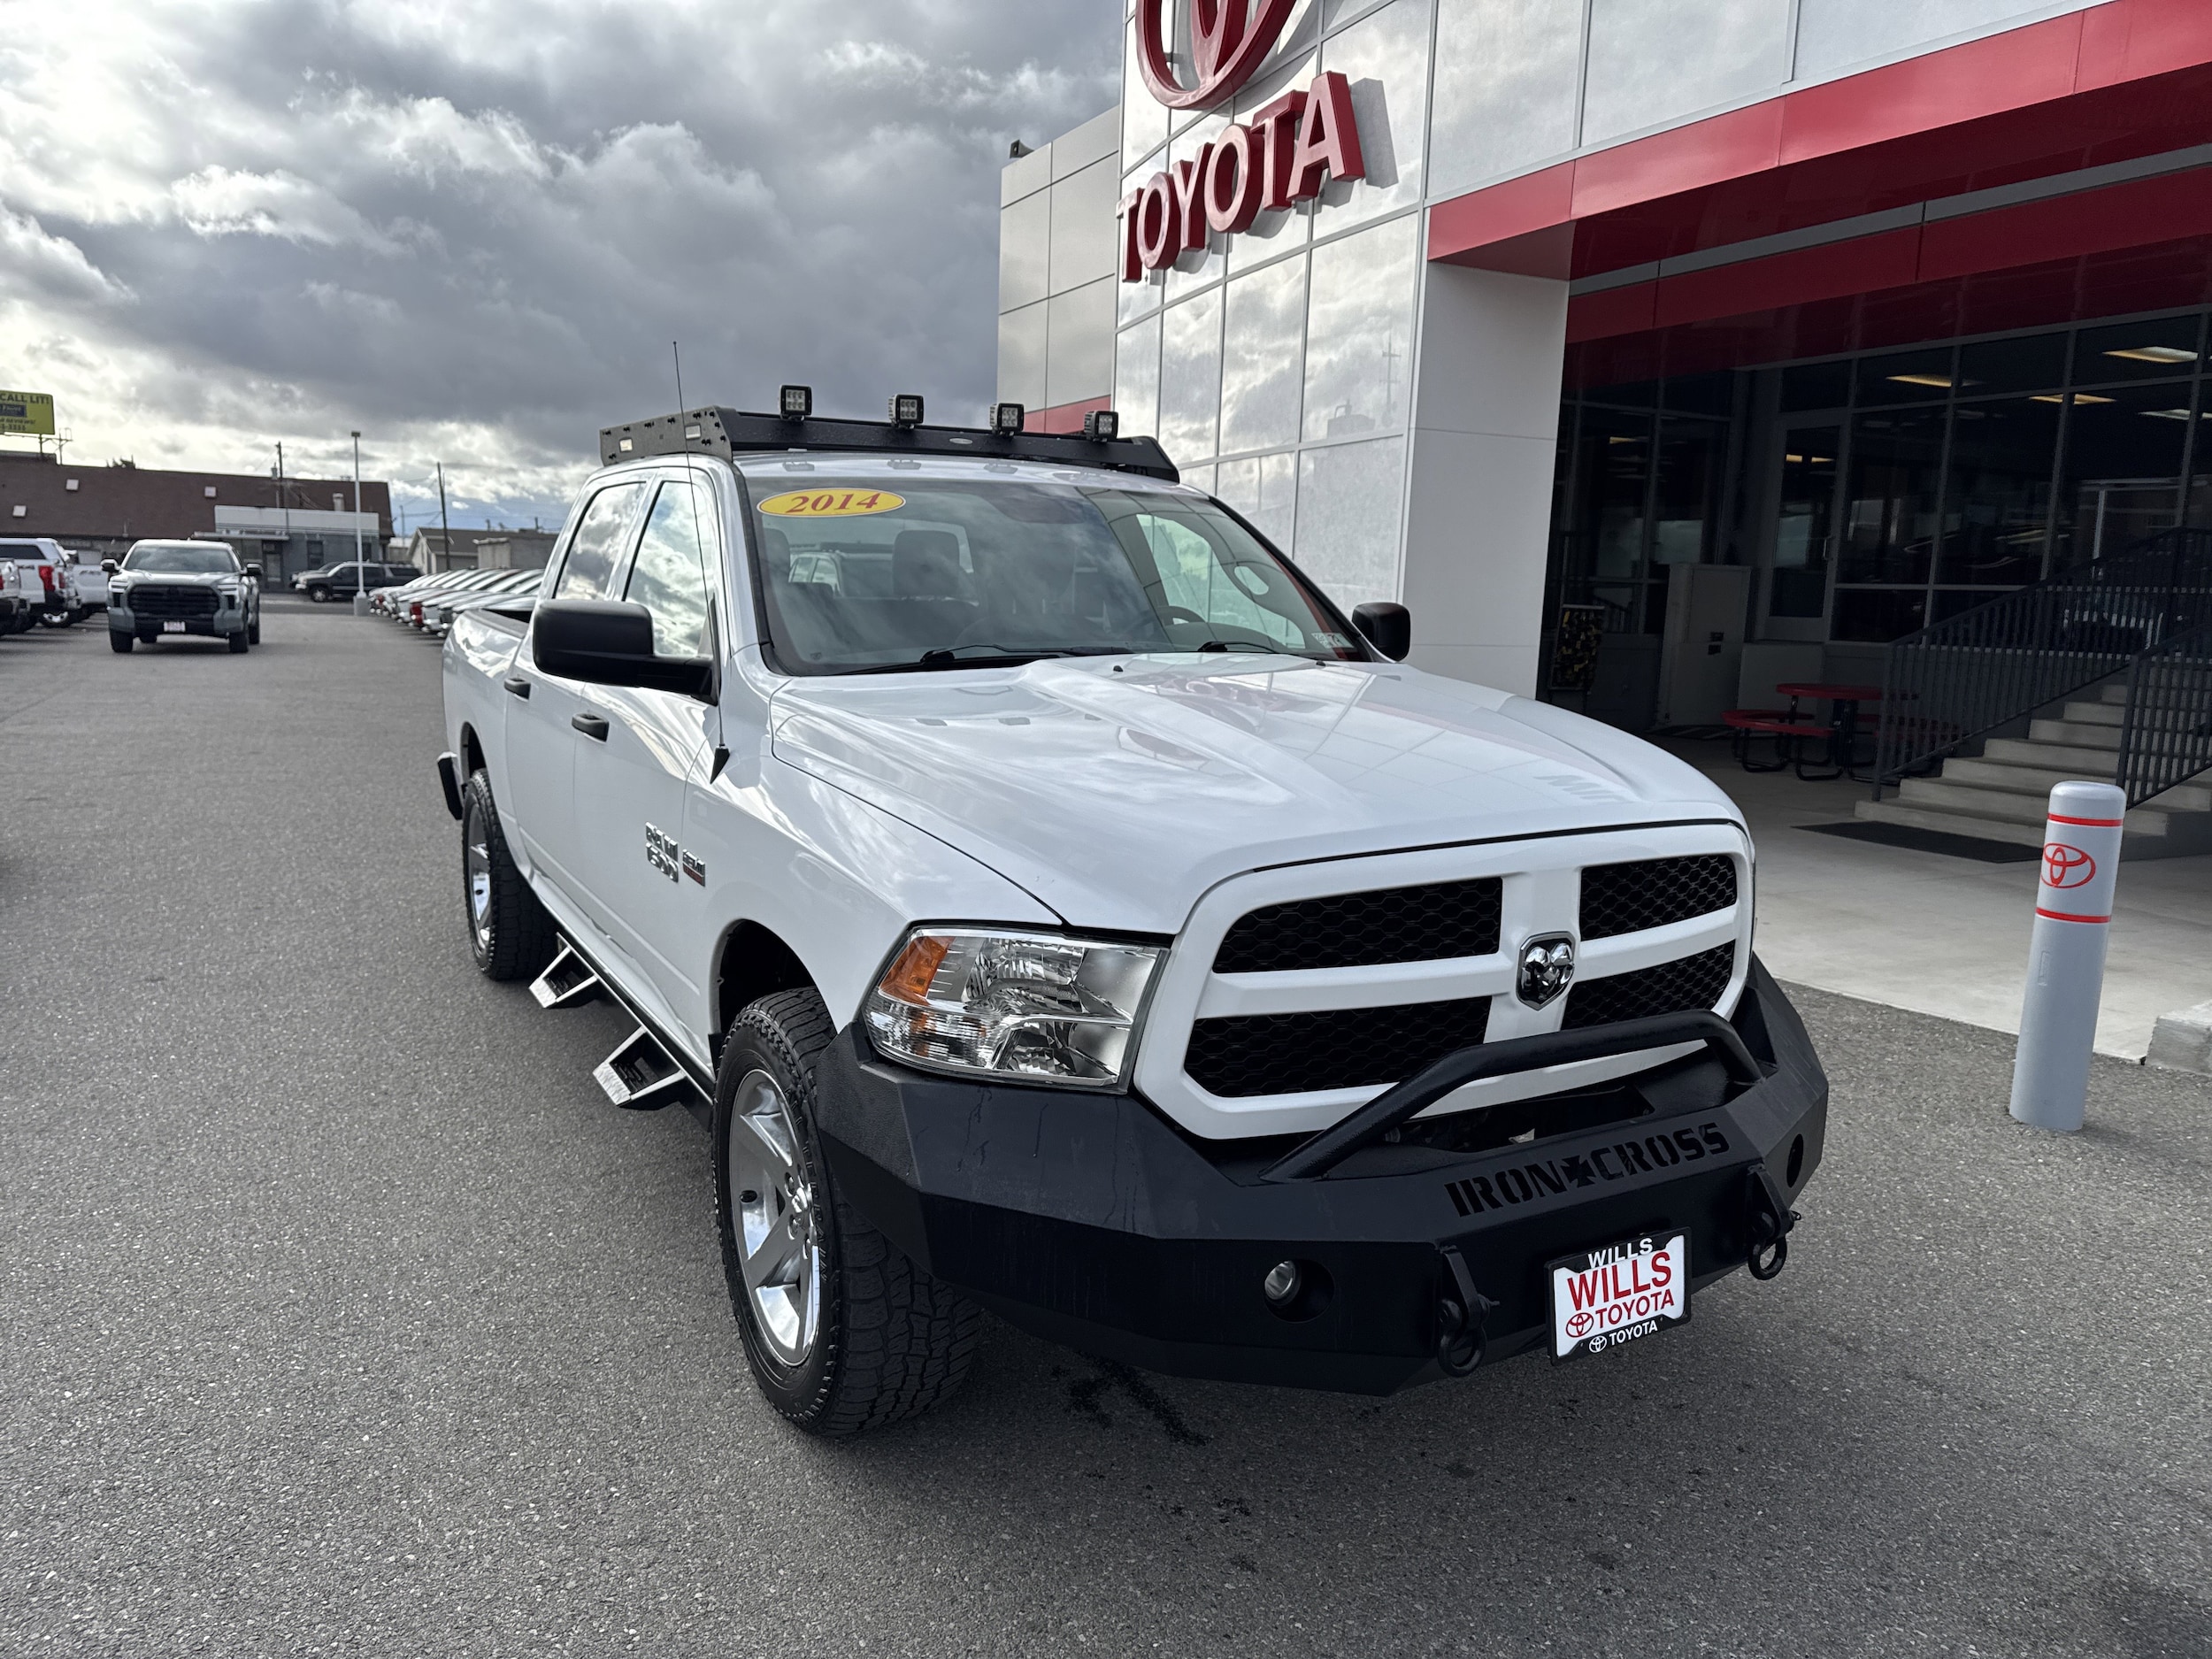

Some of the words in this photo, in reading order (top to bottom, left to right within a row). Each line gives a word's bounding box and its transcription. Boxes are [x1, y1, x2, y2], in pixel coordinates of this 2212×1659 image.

[1116, 71, 1365, 283] TOYOTA
[786, 492, 880, 513] 2014
[1444, 1160, 1568, 1217] IRON
[1590, 1122, 1731, 1181] CROSS
[1588, 1238, 1654, 1269] WILLS
[1567, 1251, 1671, 1311] WILLS
[1595, 1288, 1674, 1328] TOYOTA
[1609, 1320, 1658, 1346] TOYOTA
